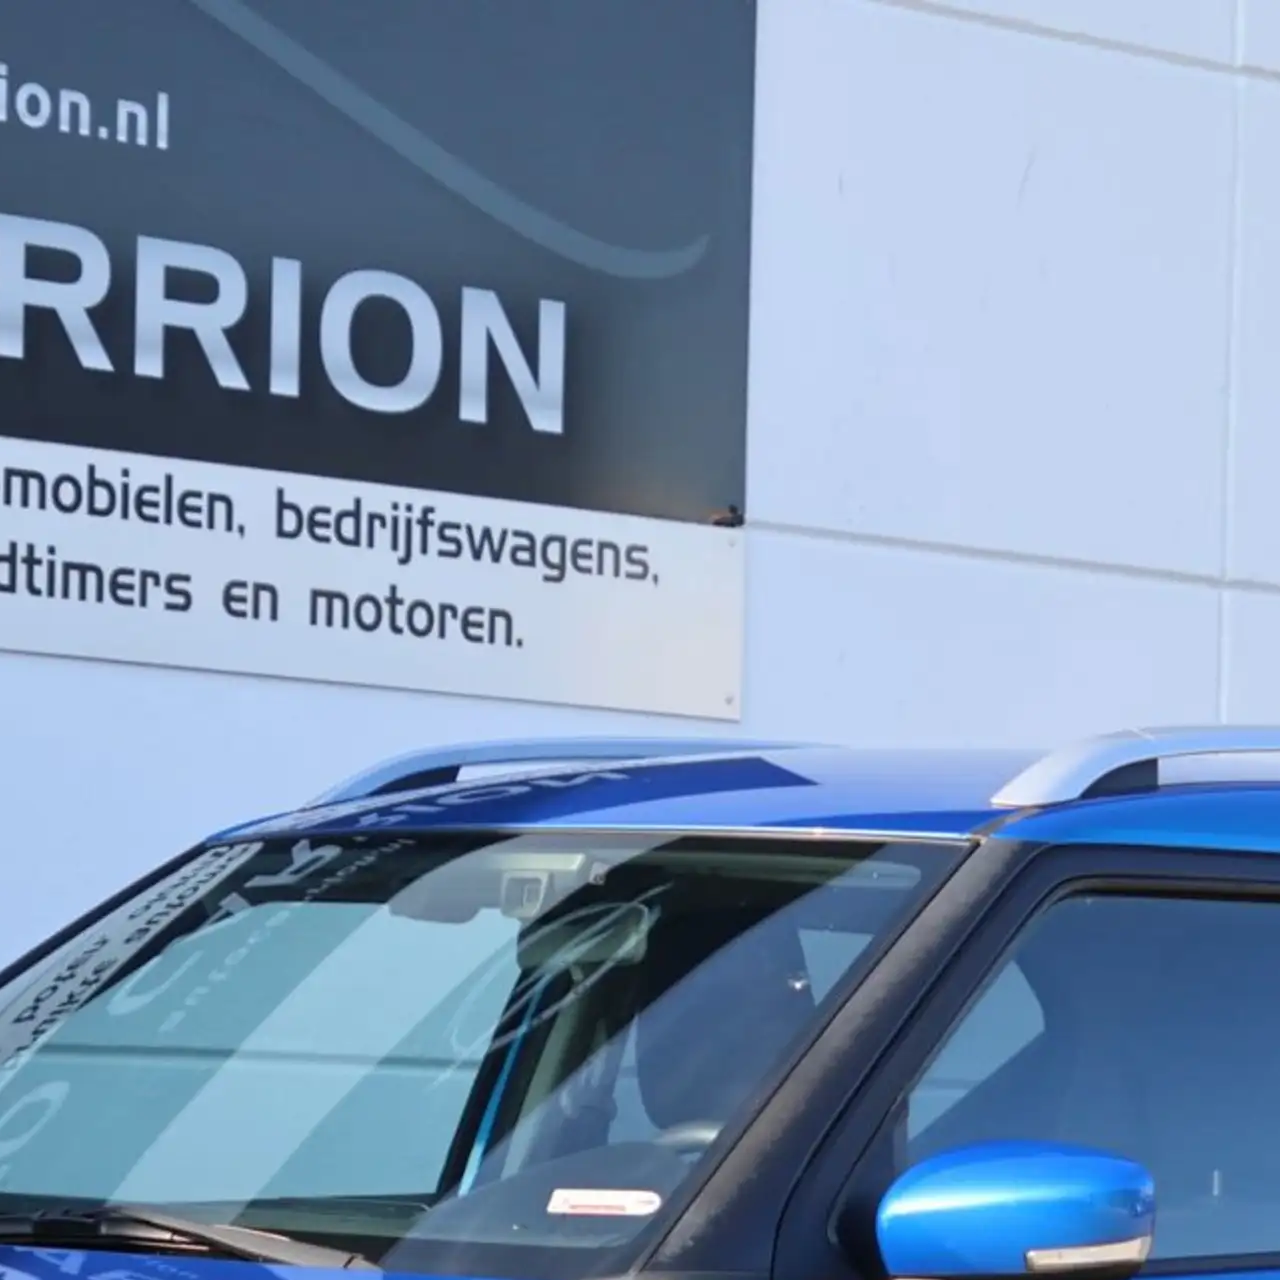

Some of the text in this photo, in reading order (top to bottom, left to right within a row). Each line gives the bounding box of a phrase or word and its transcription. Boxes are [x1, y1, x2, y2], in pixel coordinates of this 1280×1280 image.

[276, 487, 660, 587] bedrijfswagens,
[221, 579, 279, 621] en
[310, 583, 524, 649] motoren.
